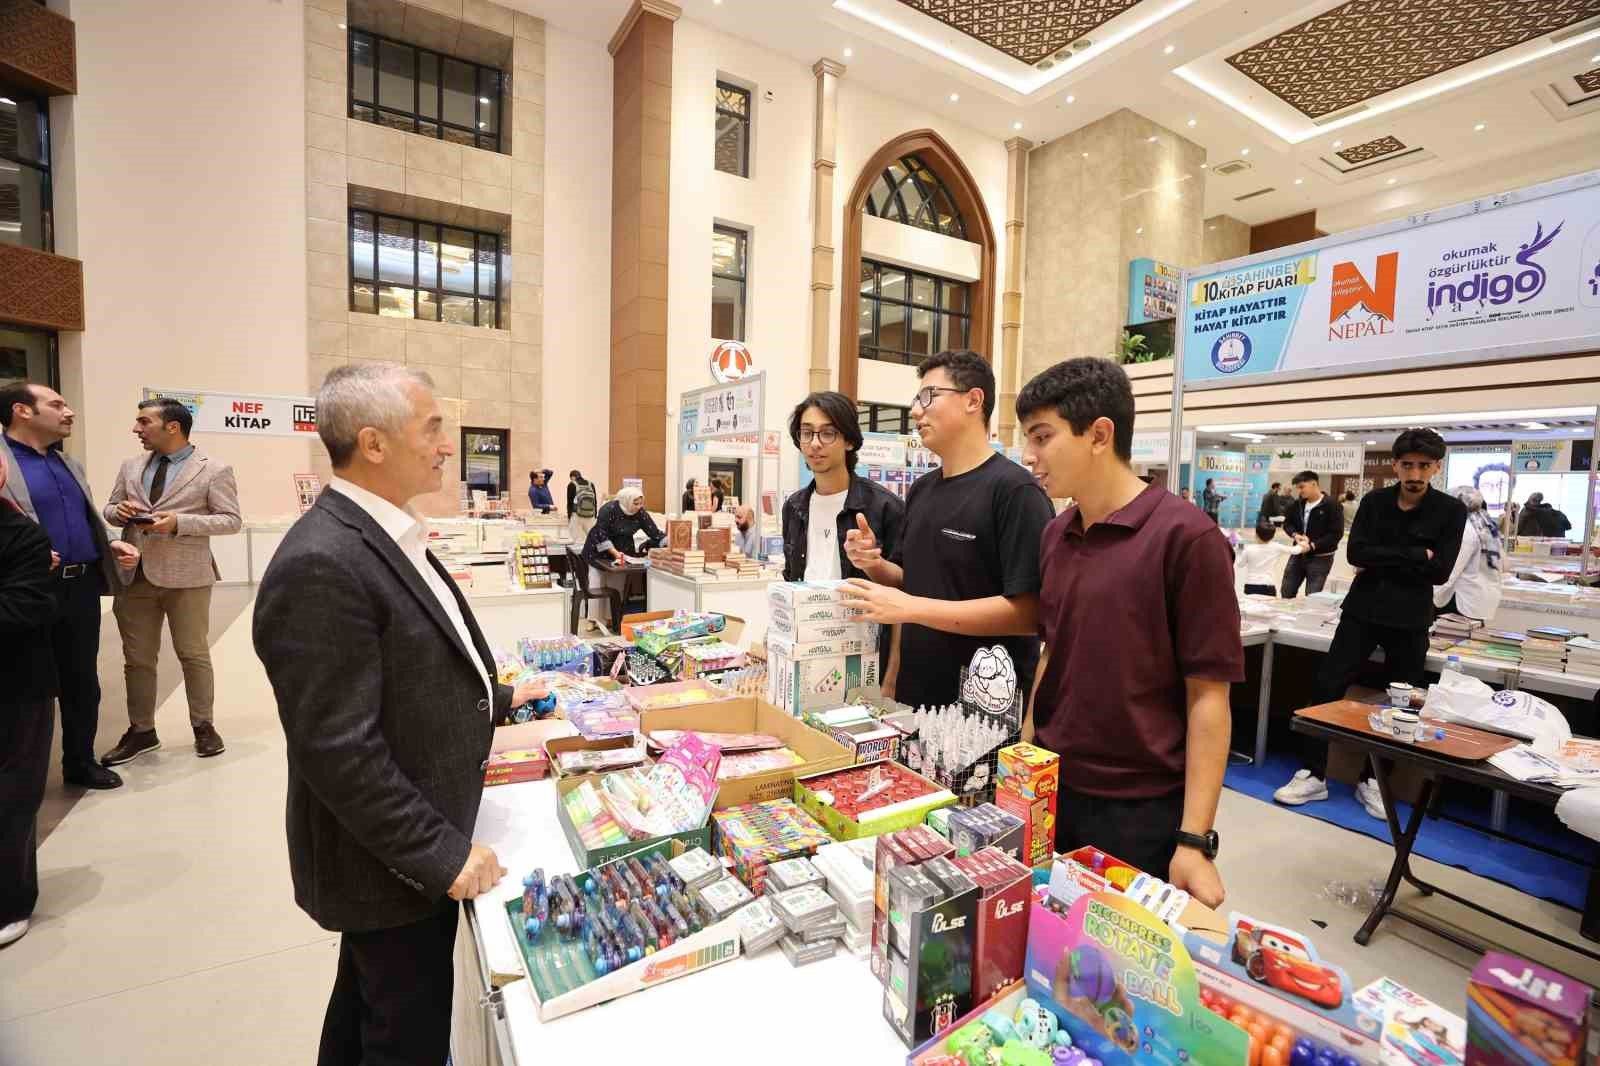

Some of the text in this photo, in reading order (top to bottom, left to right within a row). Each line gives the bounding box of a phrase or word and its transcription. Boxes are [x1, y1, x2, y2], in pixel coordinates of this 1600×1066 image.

[1442, 242, 1497, 262] okumak
[1428, 255, 1511, 279] özgürlüktür
[1257, 274, 1298, 294] FUARI
[1427, 271, 1540, 308] indigo
[1194, 296, 1288, 322] KİTAP HAYATTIR
[1194, 310, 1287, 334] HAYAT KİTAPTIR
[1328, 319, 1395, 342] NEPAL
[232, 402, 264, 414] NEF
[225, 416, 271, 429] KİTAP
[858, 740, 889, 753] WORLD
[1084, 912, 1176, 985] ROTATE
[1124, 970, 1184, 1016] BALL
